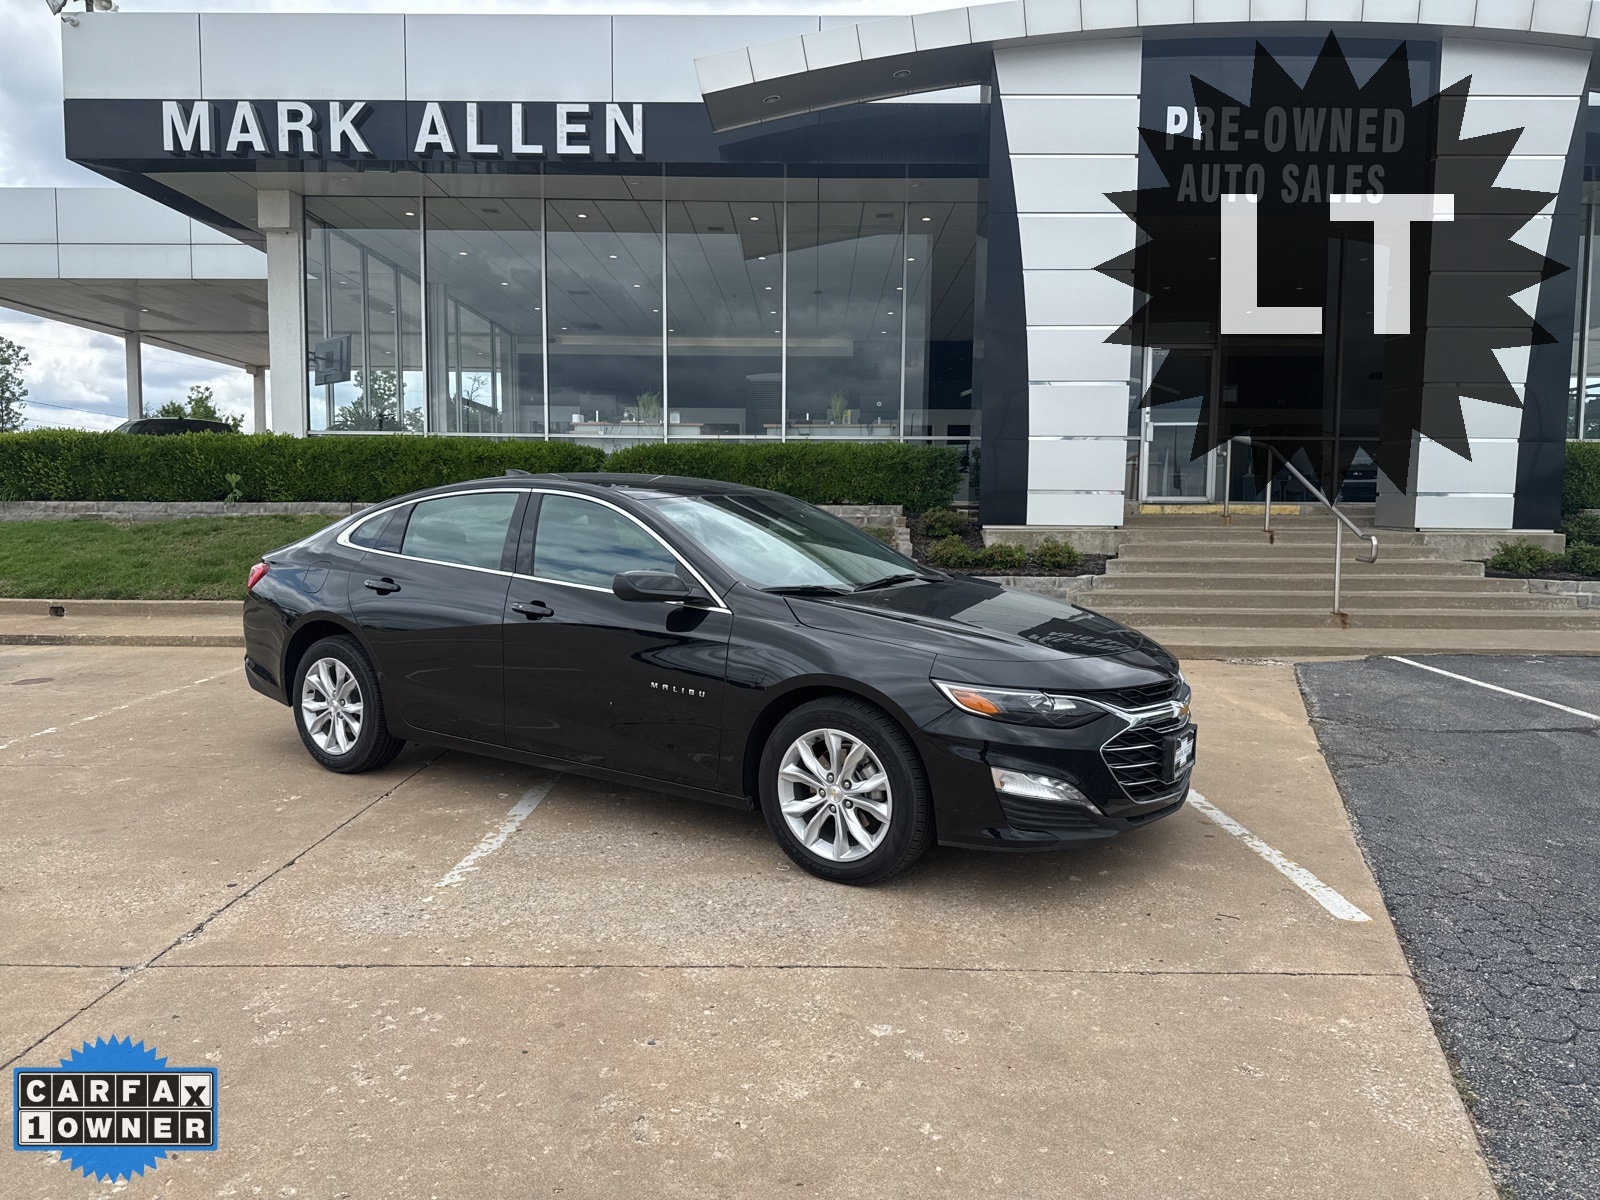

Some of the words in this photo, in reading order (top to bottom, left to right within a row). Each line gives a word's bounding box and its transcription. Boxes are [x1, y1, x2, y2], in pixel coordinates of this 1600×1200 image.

[161, 100, 371, 155] MARK
[413, 102, 645, 156] ALLEN
[1164, 105, 1406, 153] PRE-OWNED
[1176, 163, 1266, 203] AUTO
[1280, 163, 1386, 205] SALES
[650, 681, 706, 698] MALIBU
